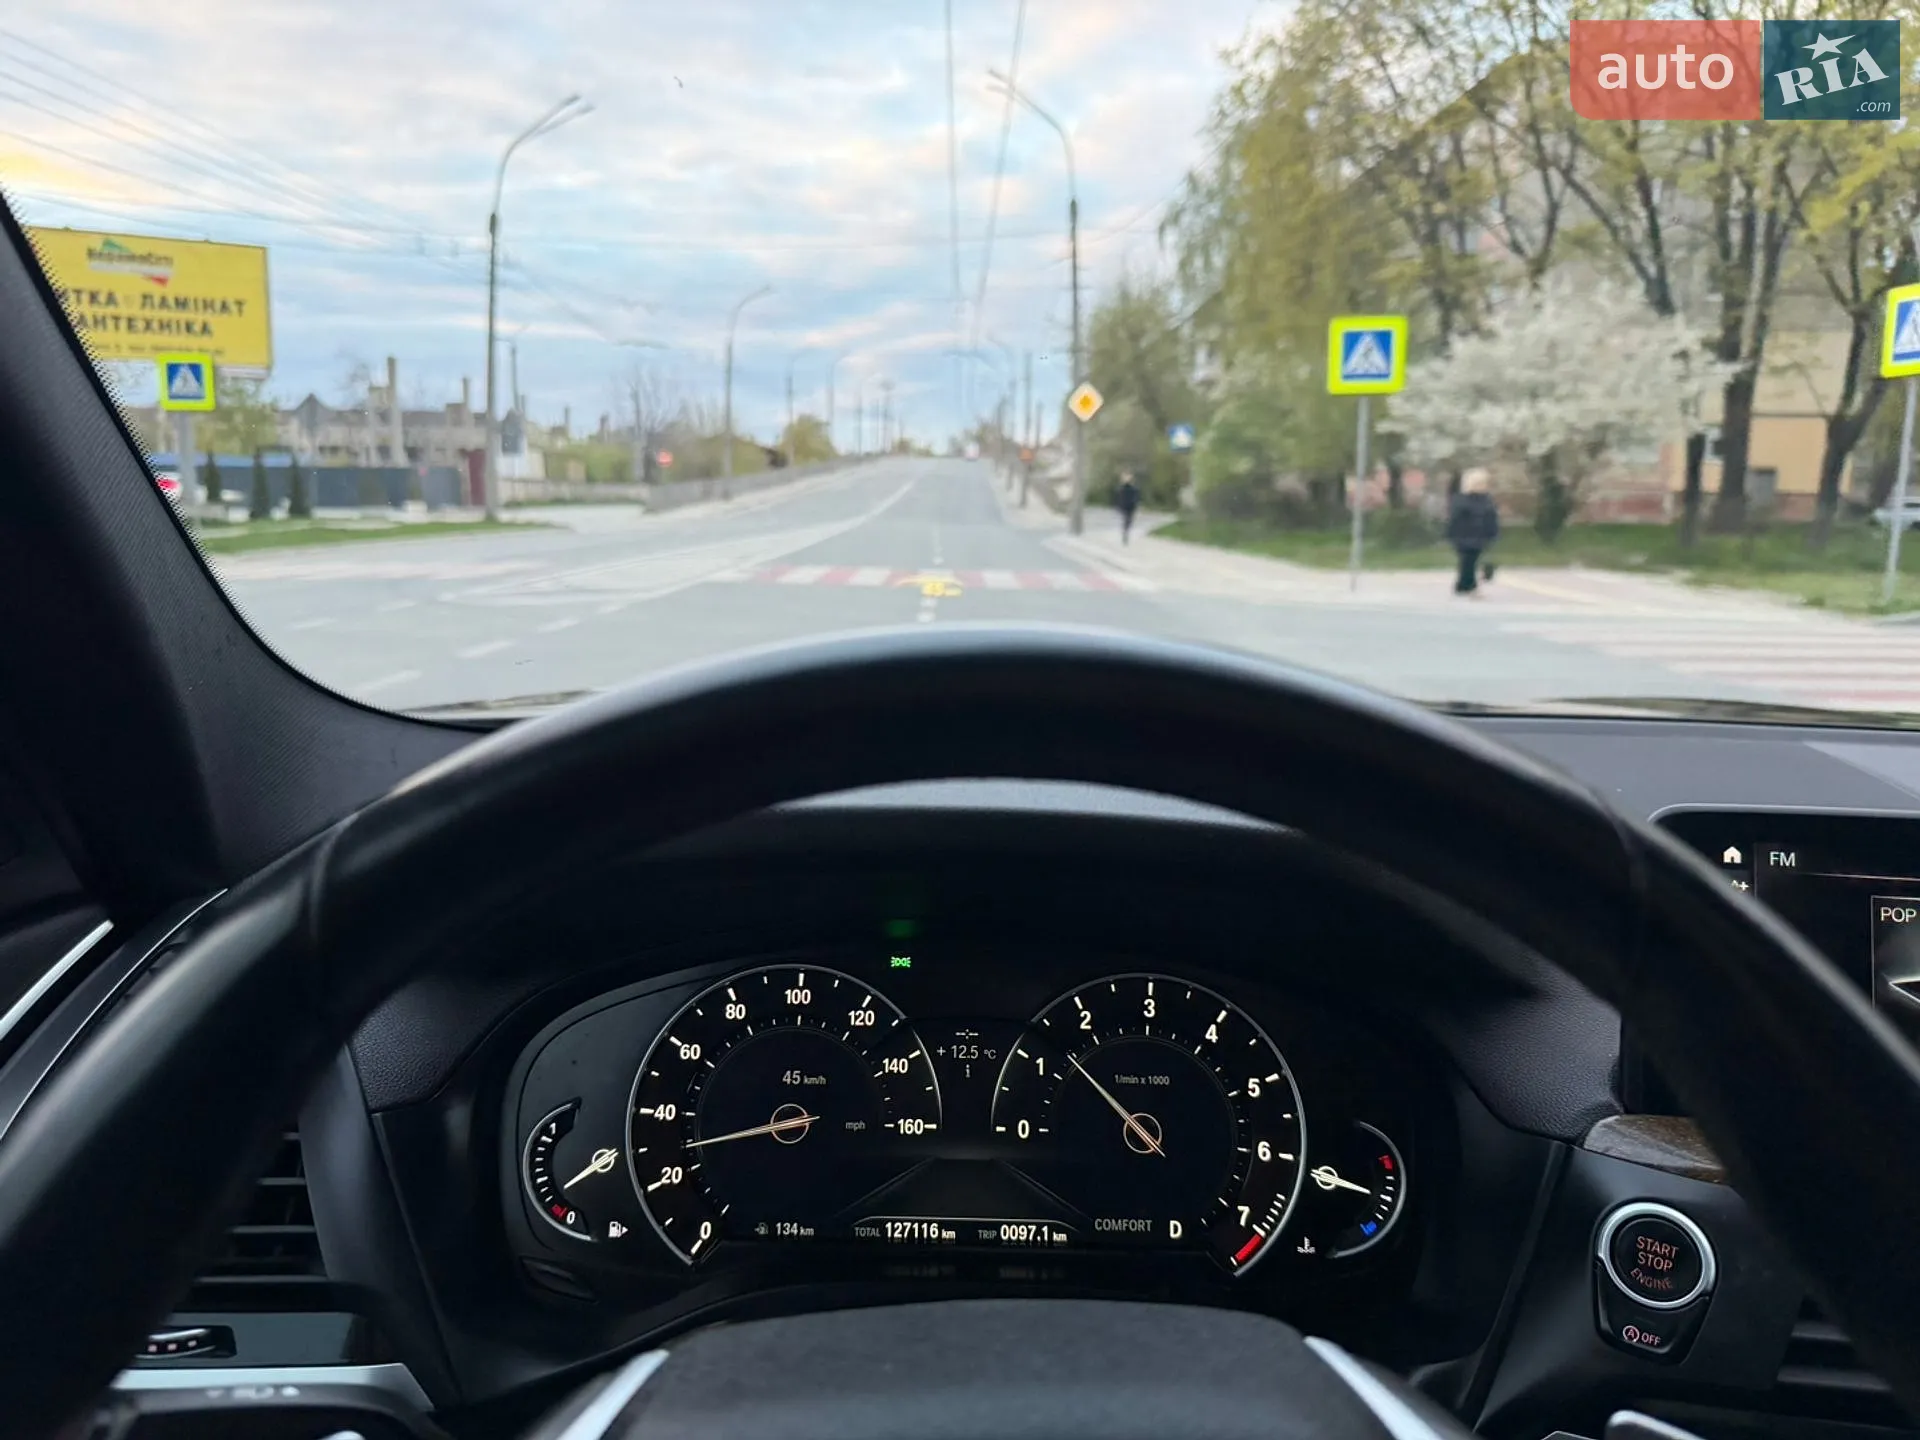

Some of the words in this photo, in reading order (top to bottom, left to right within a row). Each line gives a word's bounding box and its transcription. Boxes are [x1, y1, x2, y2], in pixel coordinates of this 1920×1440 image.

[140, 292, 247, 317] ЛАМІНАТ
[1770, 852, 1795, 866] FM
[1881, 907, 1916, 922] POP
[785, 989, 811, 1004] 100
[726, 1004, 746, 1019] 80
[1144, 999, 1155, 1017] 3
[848, 1010, 874, 1026] 120
[1080, 1011, 1091, 1029] 2
[1205, 1024, 1218, 1043] 4
[680, 1045, 700, 1060] 60
[952, 1045, 978, 1059] 12.5
[883, 1059, 908, 1074] 140
[1036, 1058, 1043, 1075] 1
[782, 1071, 801, 1085] 45
[804, 1075, 826, 1086] km/h
[1114, 1075, 1138, 1085] 1/min
[1148, 1076, 1169, 1085] 1000
[1248, 1078, 1260, 1097] 5
[653, 1104, 675, 1120] 40
[550, 1123, 556, 1134] 1
[845, 1119, 866, 1132] mph
[898, 1119, 923, 1134] 160
[1018, 1120, 1029, 1138] 0
[1258, 1141, 1271, 1161] 6
[662, 1167, 682, 1183] 20
[567, 1211, 575, 1224] 0
[1238, 1206, 1250, 1226] 7
[700, 1222, 711, 1240] 0
[776, 1223, 798, 1236] 134
[800, 1227, 814, 1235] km
[855, 1227, 880, 1237] TOTAL
[886, 1222, 938, 1238] 127116
[942, 1229, 955, 1239] km
[978, 1230, 997, 1239] TRIP
[1001, 1225, 1048, 1241] 0097.1
[1053, 1232, 1067, 1241] km
[1095, 1219, 1152, 1231] COMFORT
[1170, 1220, 1182, 1238] D
[1636, 1236, 1679, 1259] START
[1638, 1251, 1673, 1272] STOP
[1630, 1267, 1673, 1291] ENGINE
[1641, 1332, 1661, 1346] OFF
